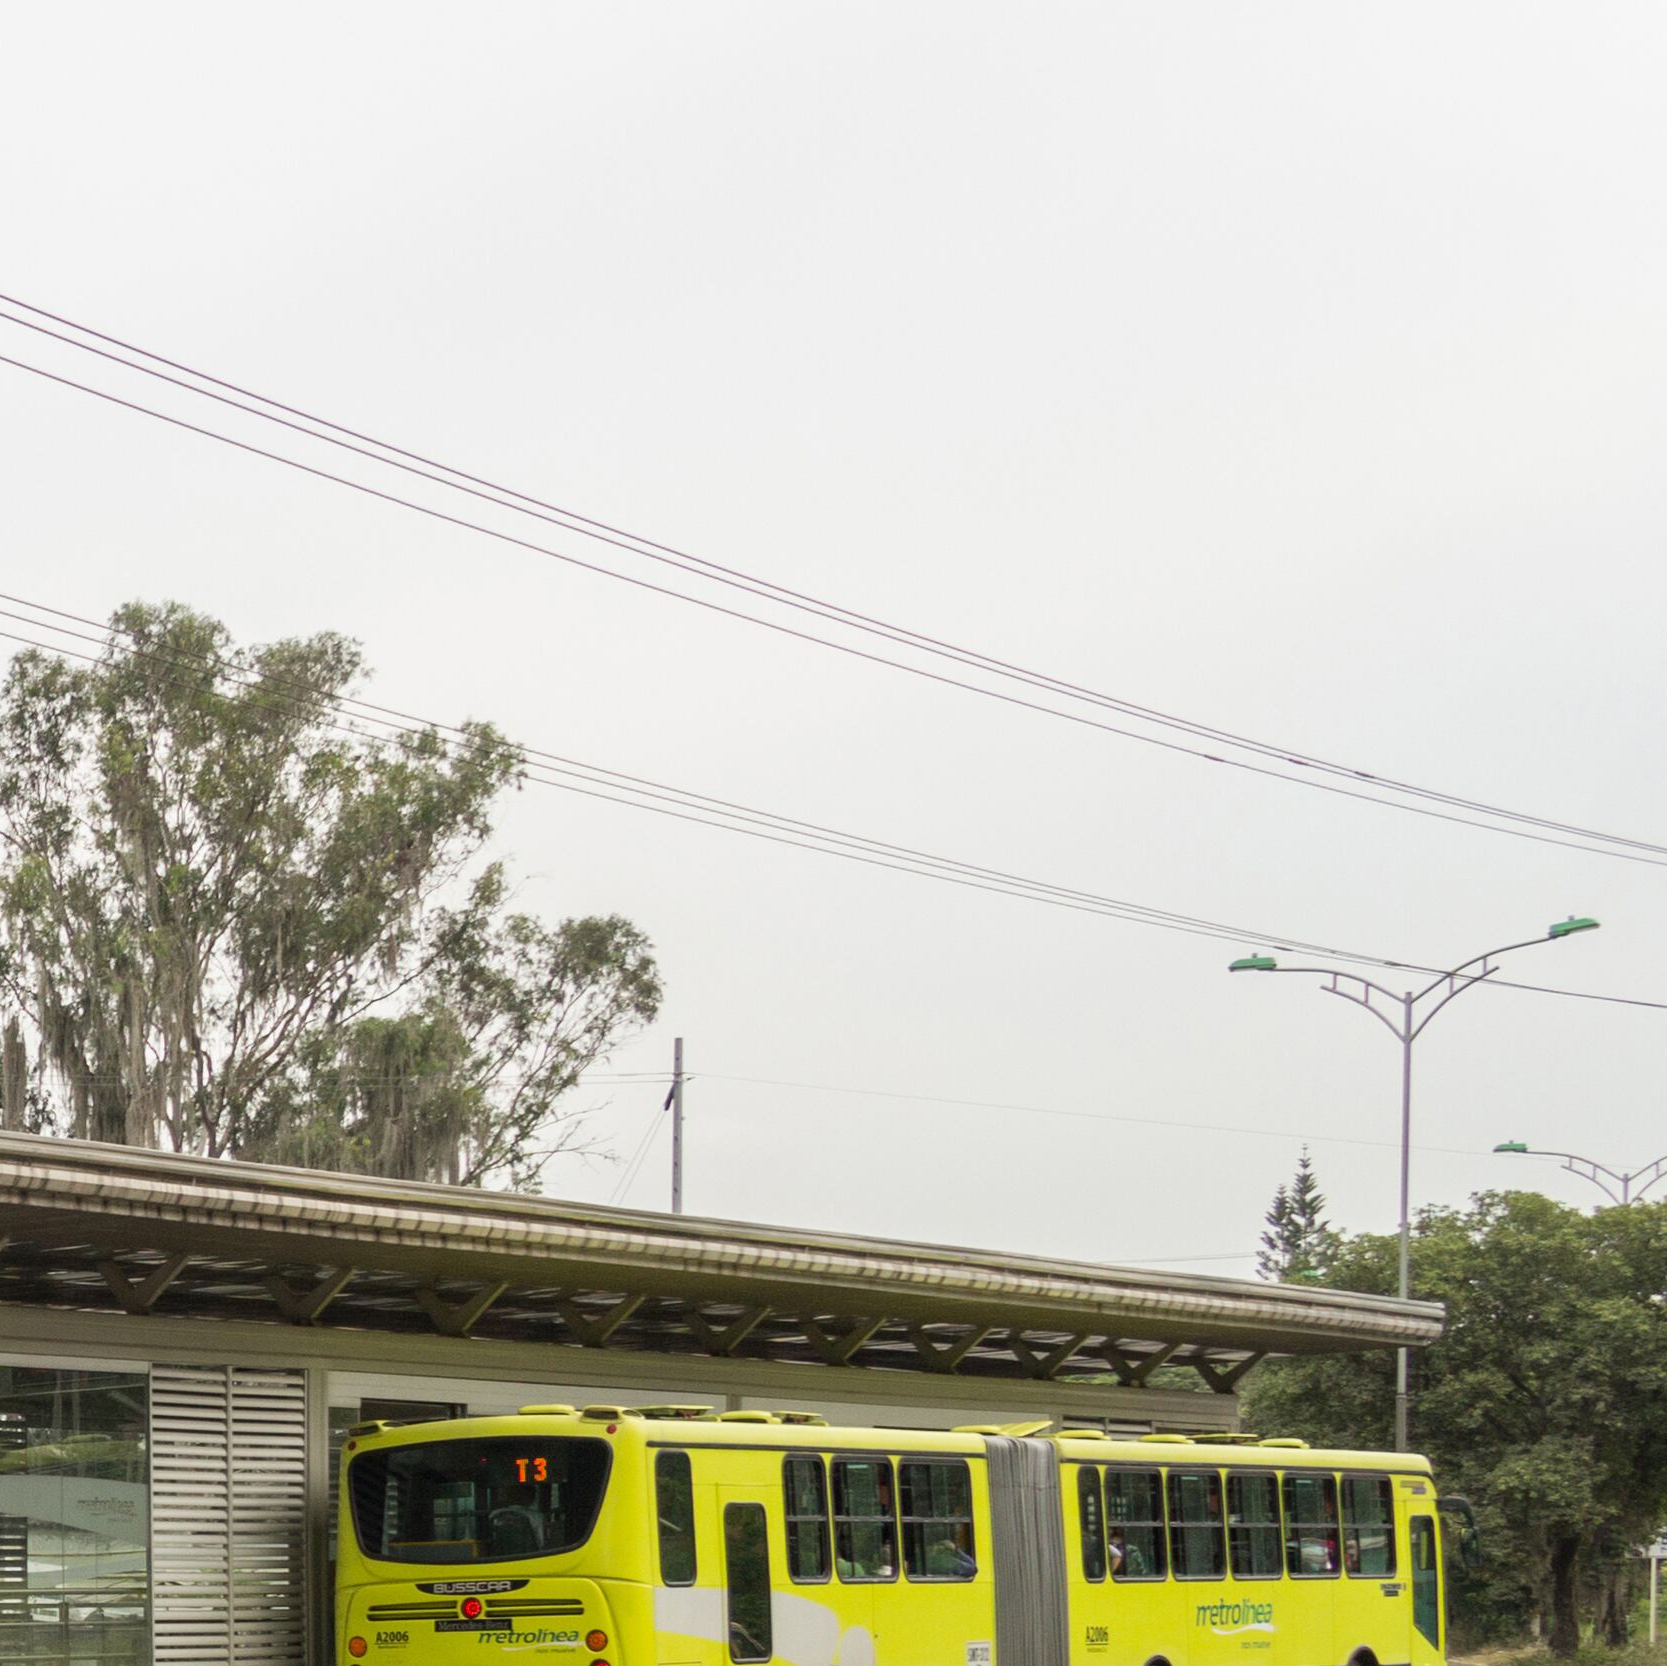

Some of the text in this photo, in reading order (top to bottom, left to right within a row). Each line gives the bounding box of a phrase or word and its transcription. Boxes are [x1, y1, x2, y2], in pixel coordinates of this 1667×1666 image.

[434, 1580, 511, 1593] BUSSCAR
[376, 1631, 409, 1642] A2006
[1086, 1626, 1108, 1642] A2006
